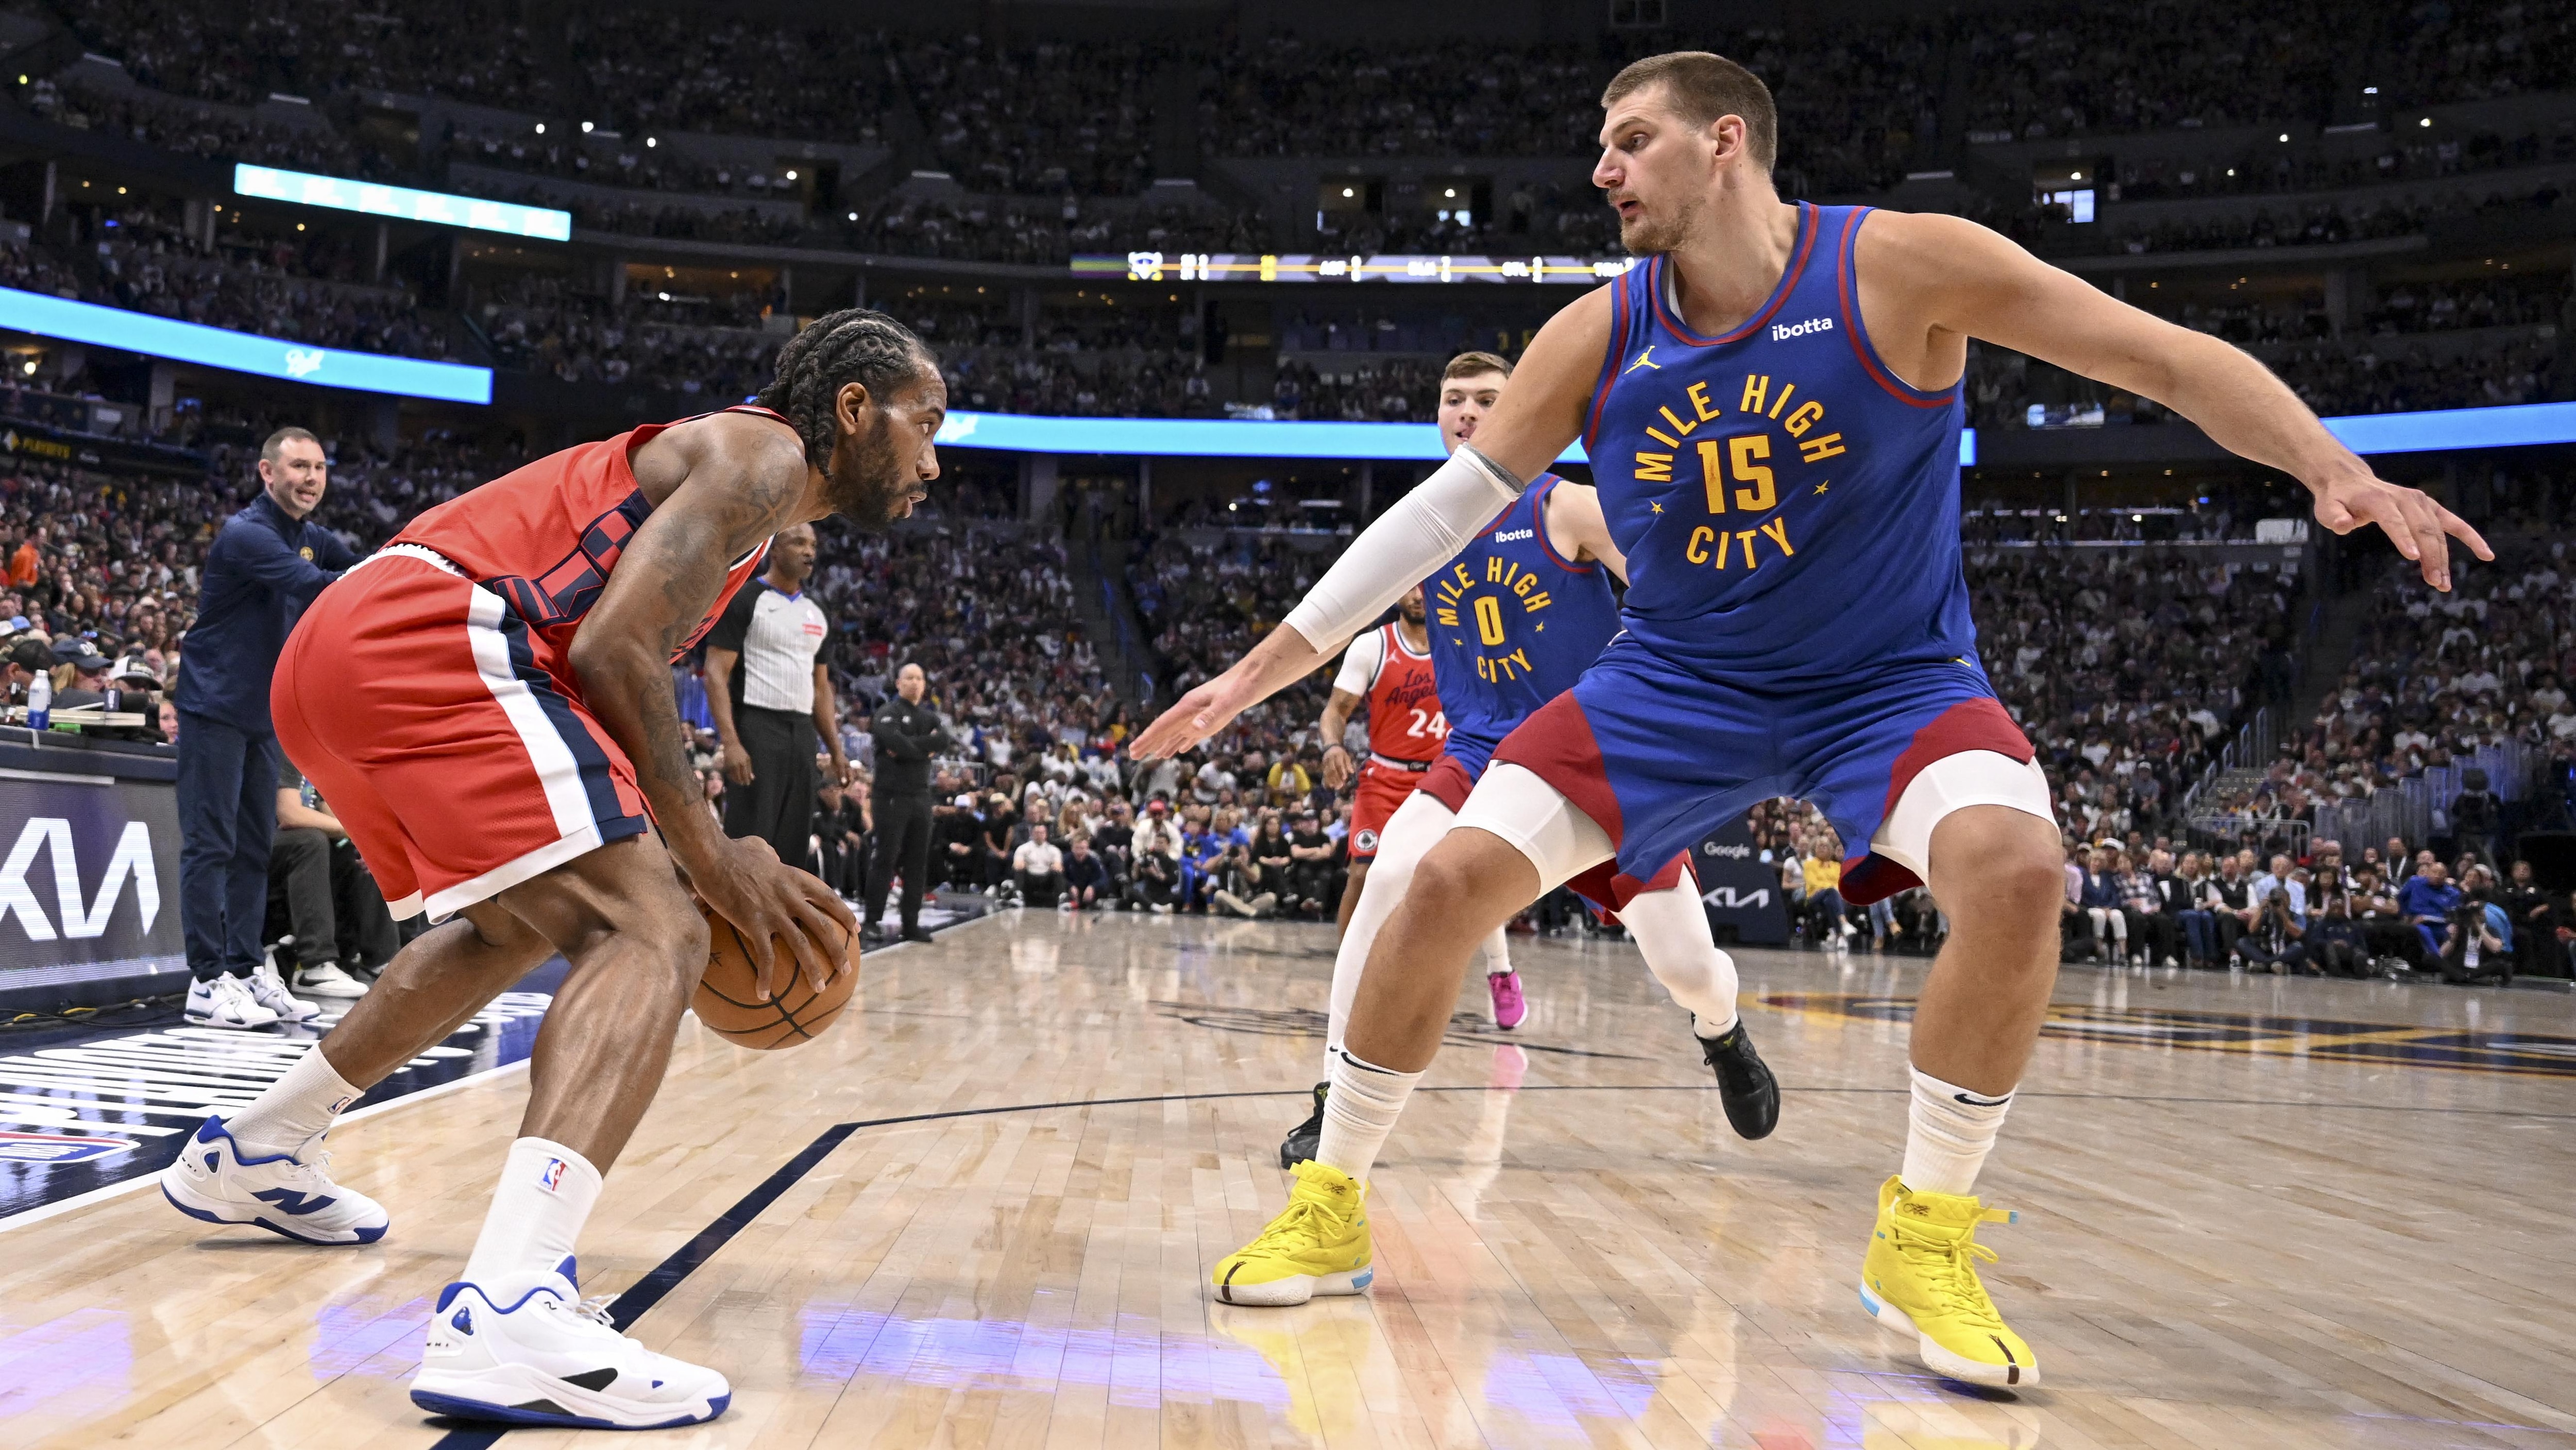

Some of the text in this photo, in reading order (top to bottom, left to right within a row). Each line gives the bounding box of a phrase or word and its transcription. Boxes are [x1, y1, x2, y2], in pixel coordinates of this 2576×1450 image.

[1772, 317, 1833, 342] ibotta
[1634, 373, 1847, 482] MILE HIGH
[1697, 434, 1777, 514] 15
[1495, 528, 1533, 543] ibotta
[1686, 516, 1796, 570] CITY
[1436, 556, 1552, 626] MILE HIGH
[1474, 595, 1505, 646] 0
[1404, 669, 1432, 688] Los
[1477, 647, 1533, 684] CITY
[1406, 708, 1446, 740] 24
[1703, 841, 1751, 860] Google
